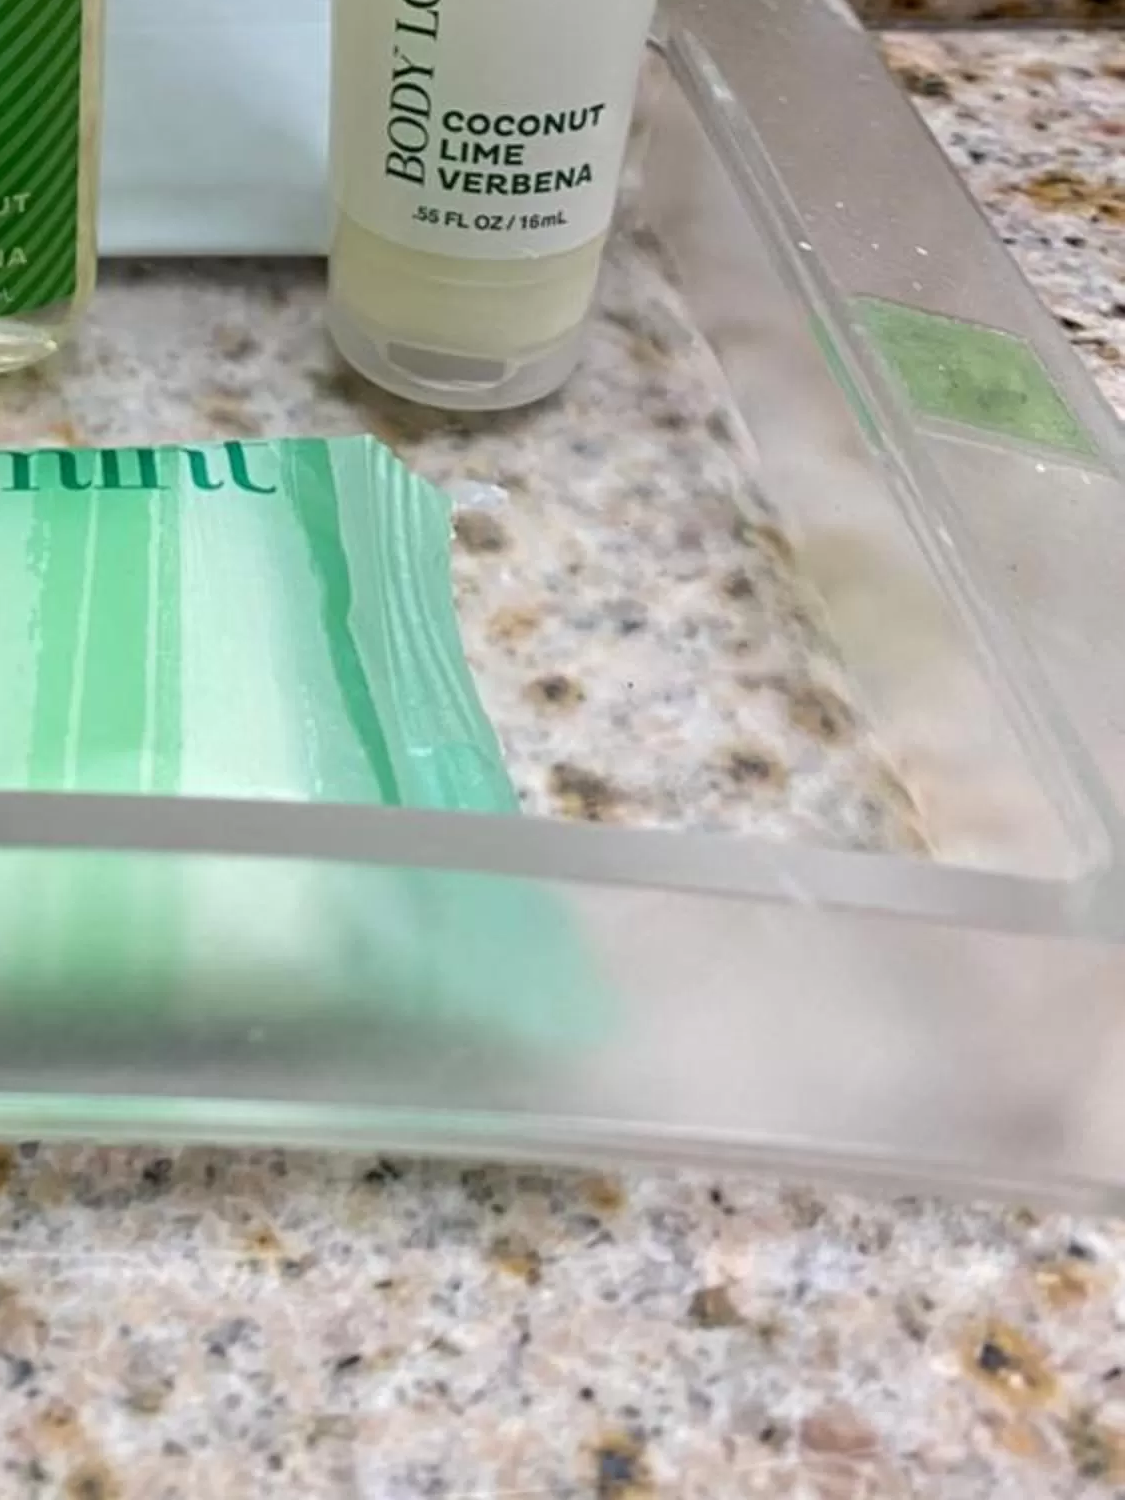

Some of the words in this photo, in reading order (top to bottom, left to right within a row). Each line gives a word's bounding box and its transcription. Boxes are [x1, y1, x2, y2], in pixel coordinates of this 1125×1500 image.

[384, 44, 436, 187] BODY
[441, 102, 607, 138] COCONUT
[438, 138, 526, 167] LIME
[437, 162, 594, 196] VERBENA
[443, 210, 470, 229] FL
[473, 214, 504, 232] OZ
